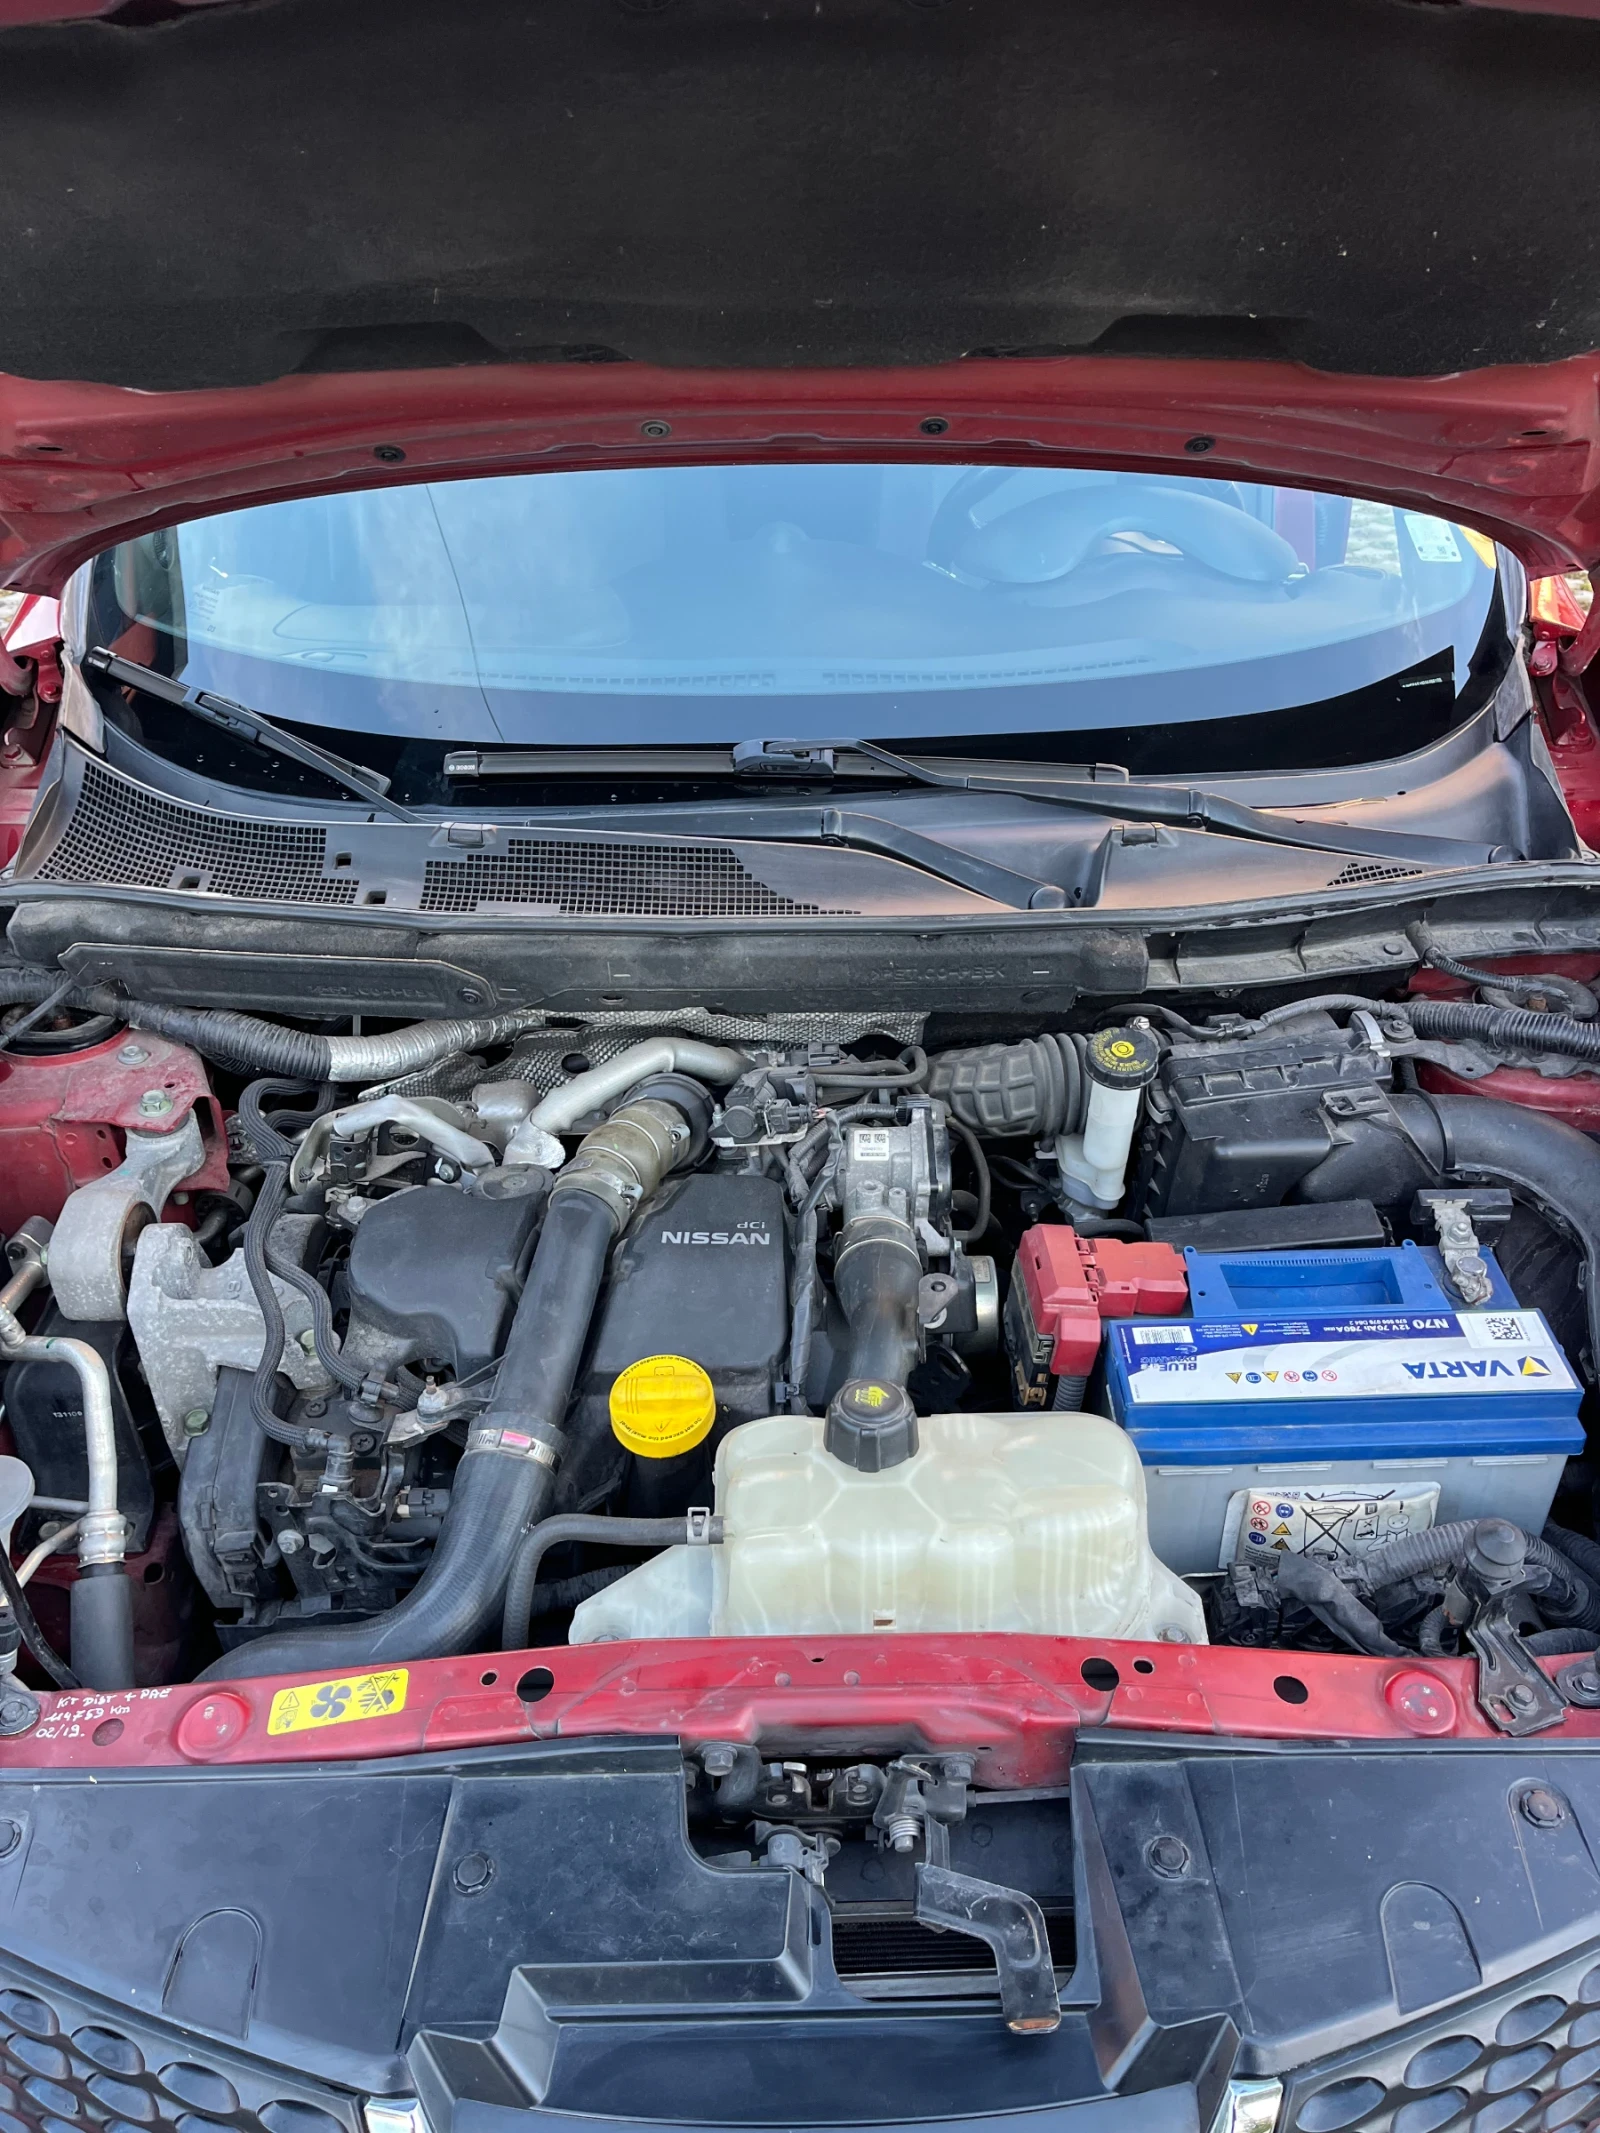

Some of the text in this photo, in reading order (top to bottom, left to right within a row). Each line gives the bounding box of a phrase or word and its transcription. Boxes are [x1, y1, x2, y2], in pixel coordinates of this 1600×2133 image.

[736, 1221, 766, 1229] dCi
[660, 1230, 771, 1246] NISSAN
[1412, 1318, 1450, 1330] N70
[1140, 1356, 1198, 1365] DYNAMIC
[1159, 1362, 1198, 1372] BLUE
[1401, 1360, 1515, 1380] VARTA
[684, 1423, 695, 1433] not
[124, 1691, 137, 1702] +
